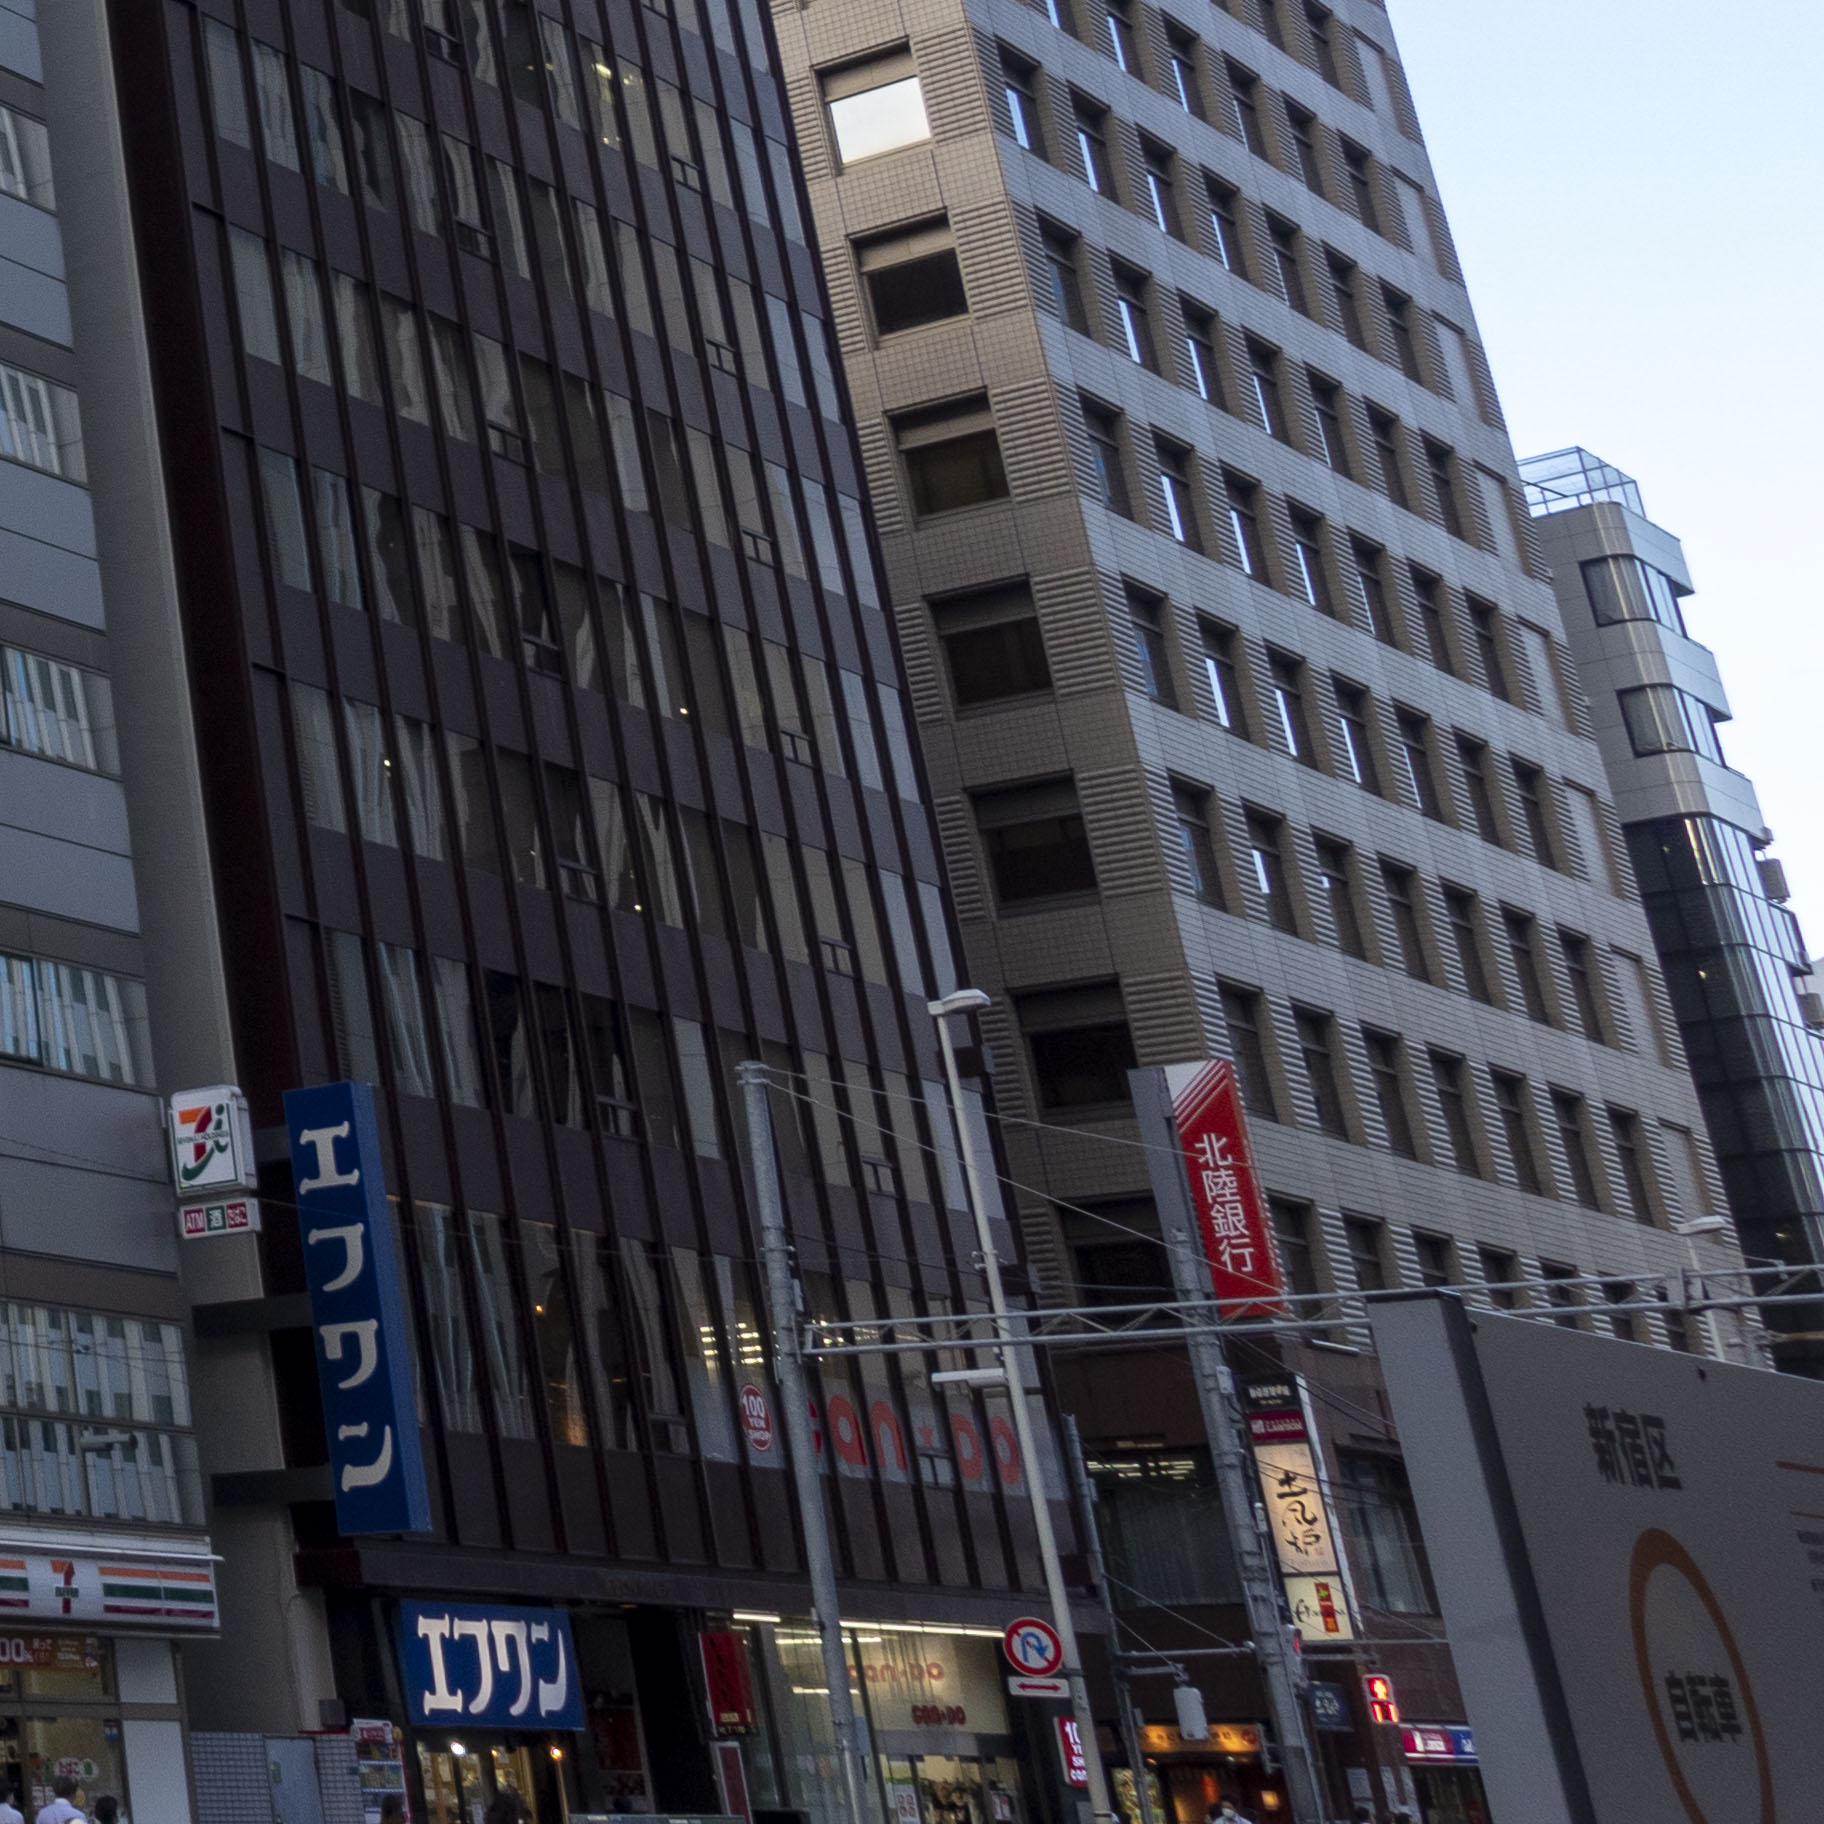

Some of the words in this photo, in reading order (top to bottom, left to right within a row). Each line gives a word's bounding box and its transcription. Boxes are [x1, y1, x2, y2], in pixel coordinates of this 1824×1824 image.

[185, 1210, 205, 1232] ATM
[1194, 1131, 1255, 1275] 北陸銀行
[298, 1120, 395, 1493] エフワン
[742, 1394, 766, 1418] 100
[1582, 1401, 1683, 1491] 新宿区
[416, 1612, 570, 1718] エフワン
[1664, 1669, 1744, 1744] 自転車
